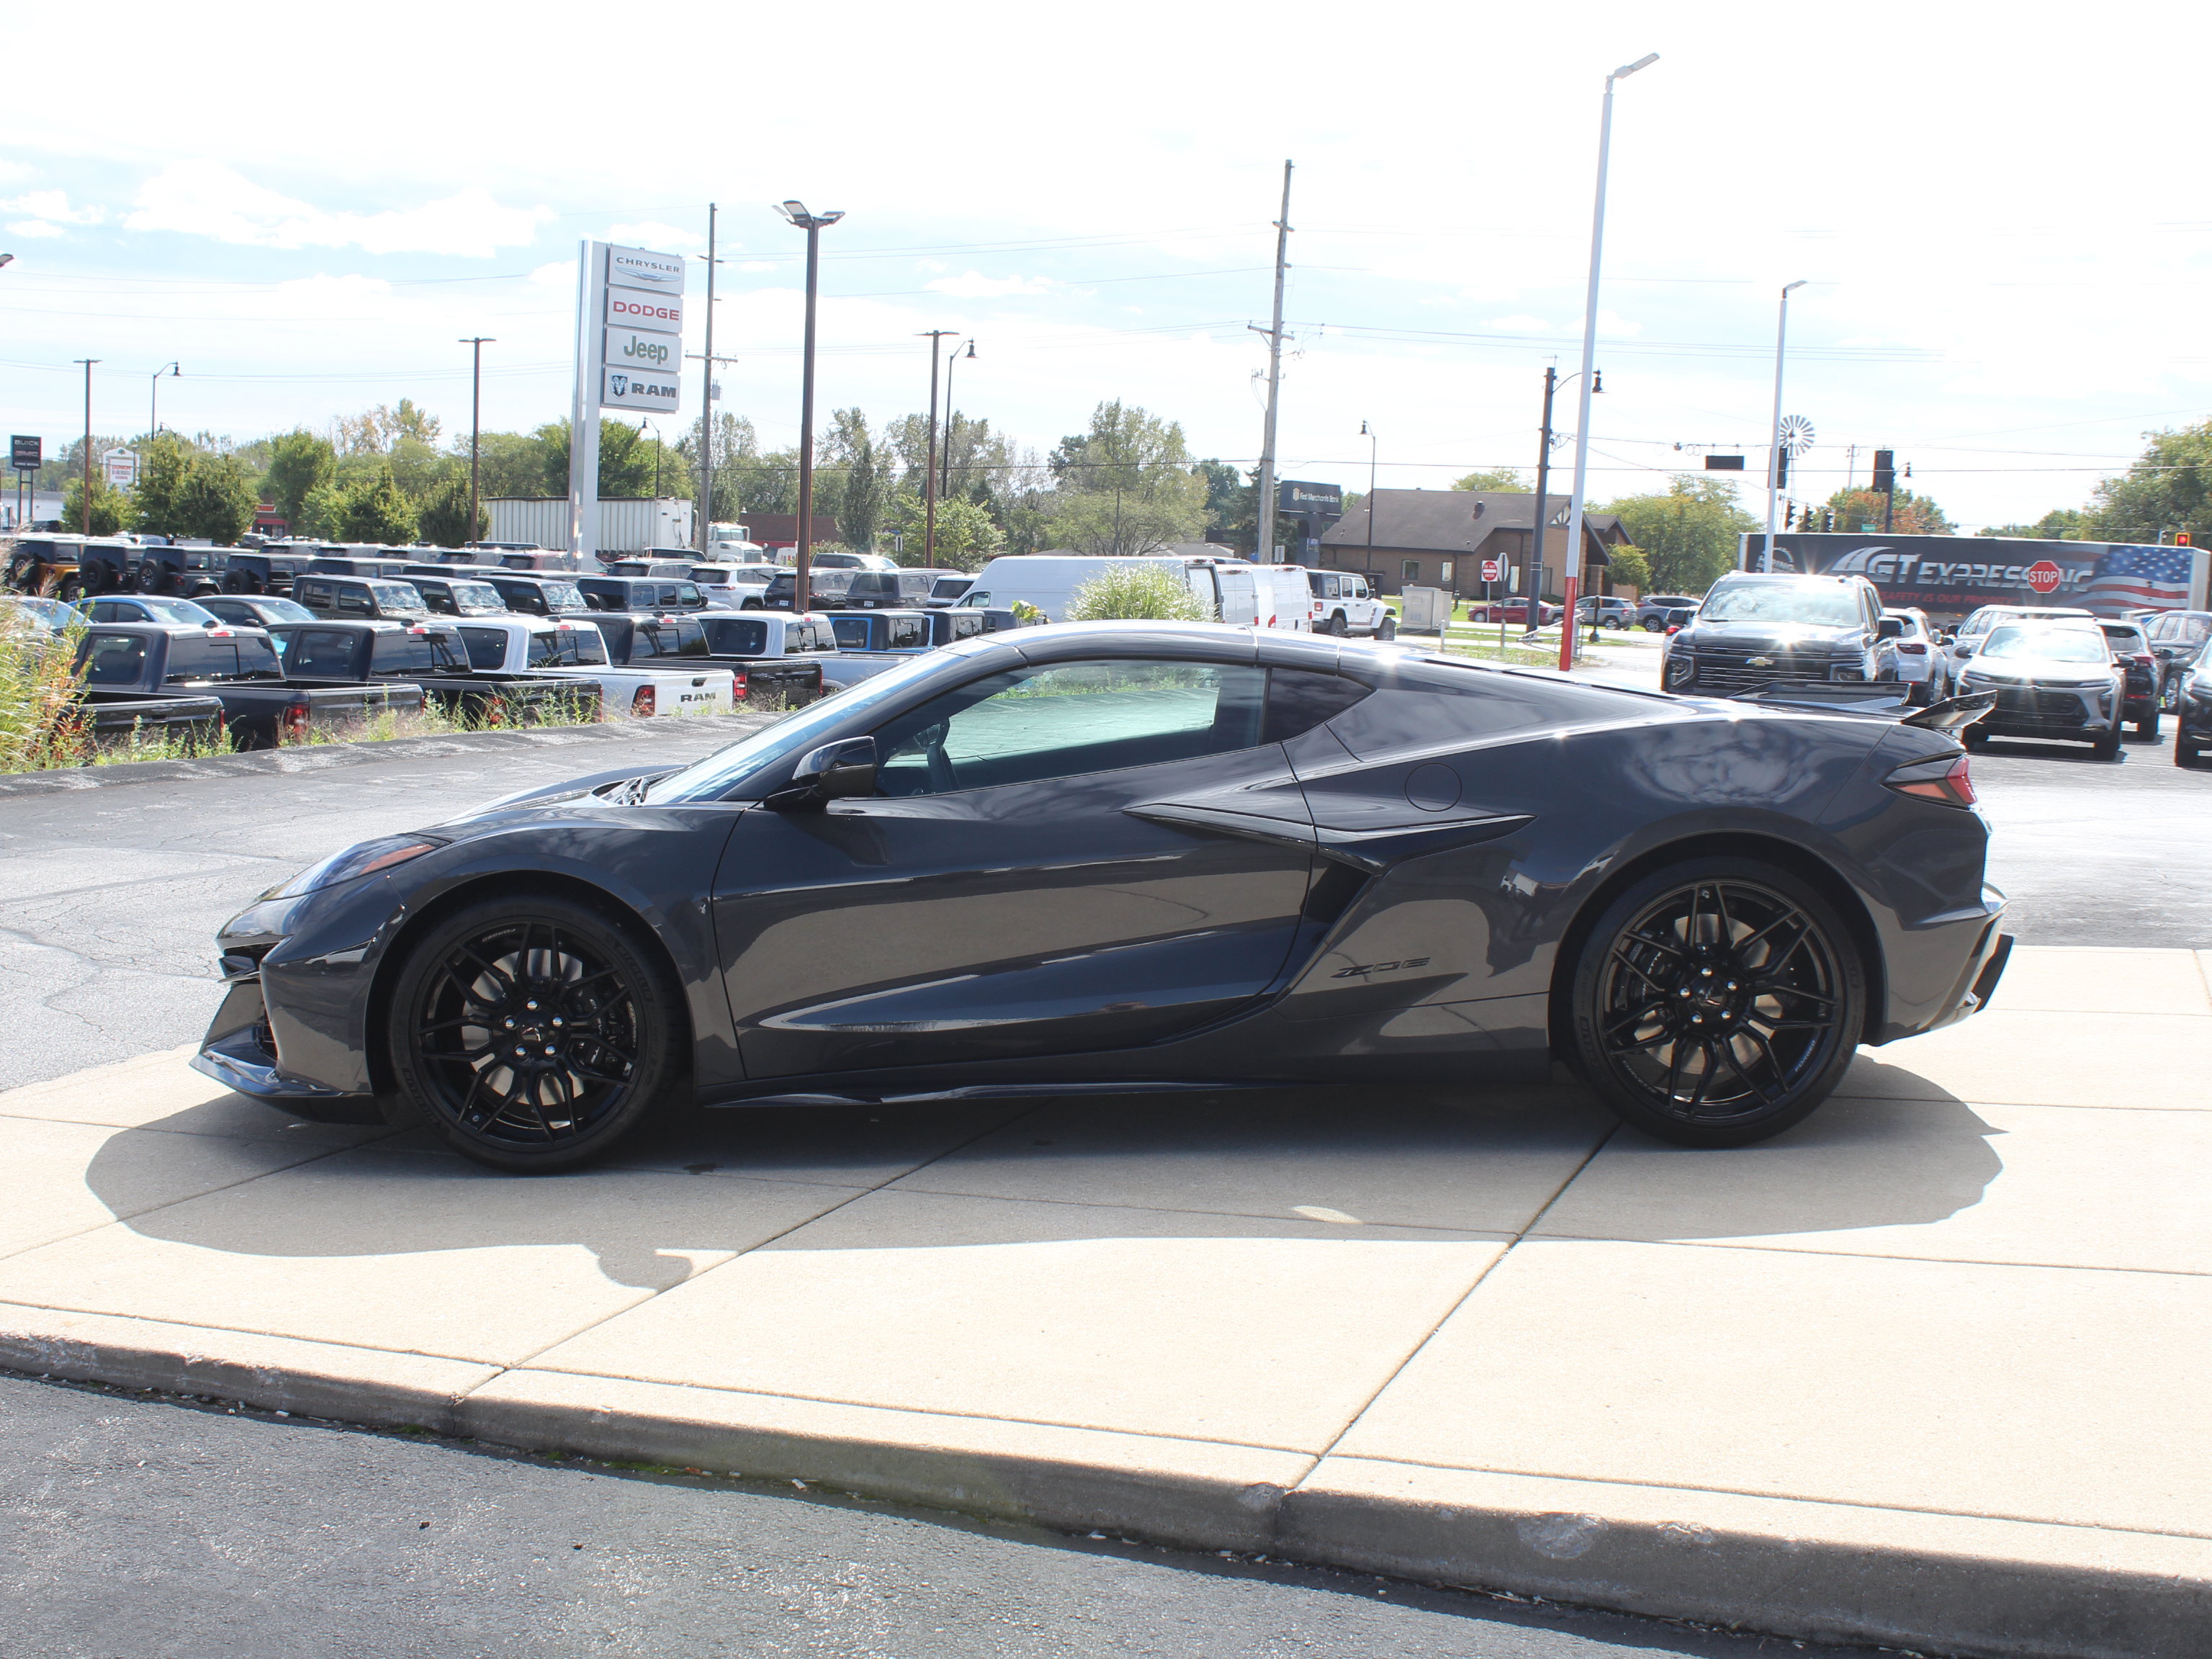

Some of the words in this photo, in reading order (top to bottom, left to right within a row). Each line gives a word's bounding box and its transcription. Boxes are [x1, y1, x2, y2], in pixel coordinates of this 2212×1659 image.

[616, 256, 680, 274] CHRYSLER
[613, 300, 680, 321] DODGE
[624, 335, 669, 365] Jeep
[631, 382, 677, 398] RAM
[1308, 493, 1329, 503] Merchants
[1329, 495, 1339, 503] Bank
[1867, 554, 1923, 583] GT
[2029, 570, 2058, 583] STOP
[680, 692, 716, 703] RAM
[482, 928, 516, 943] FORGED
[1330, 957, 1431, 979] Z06
[1794, 1040, 1816, 1072] FORGED
